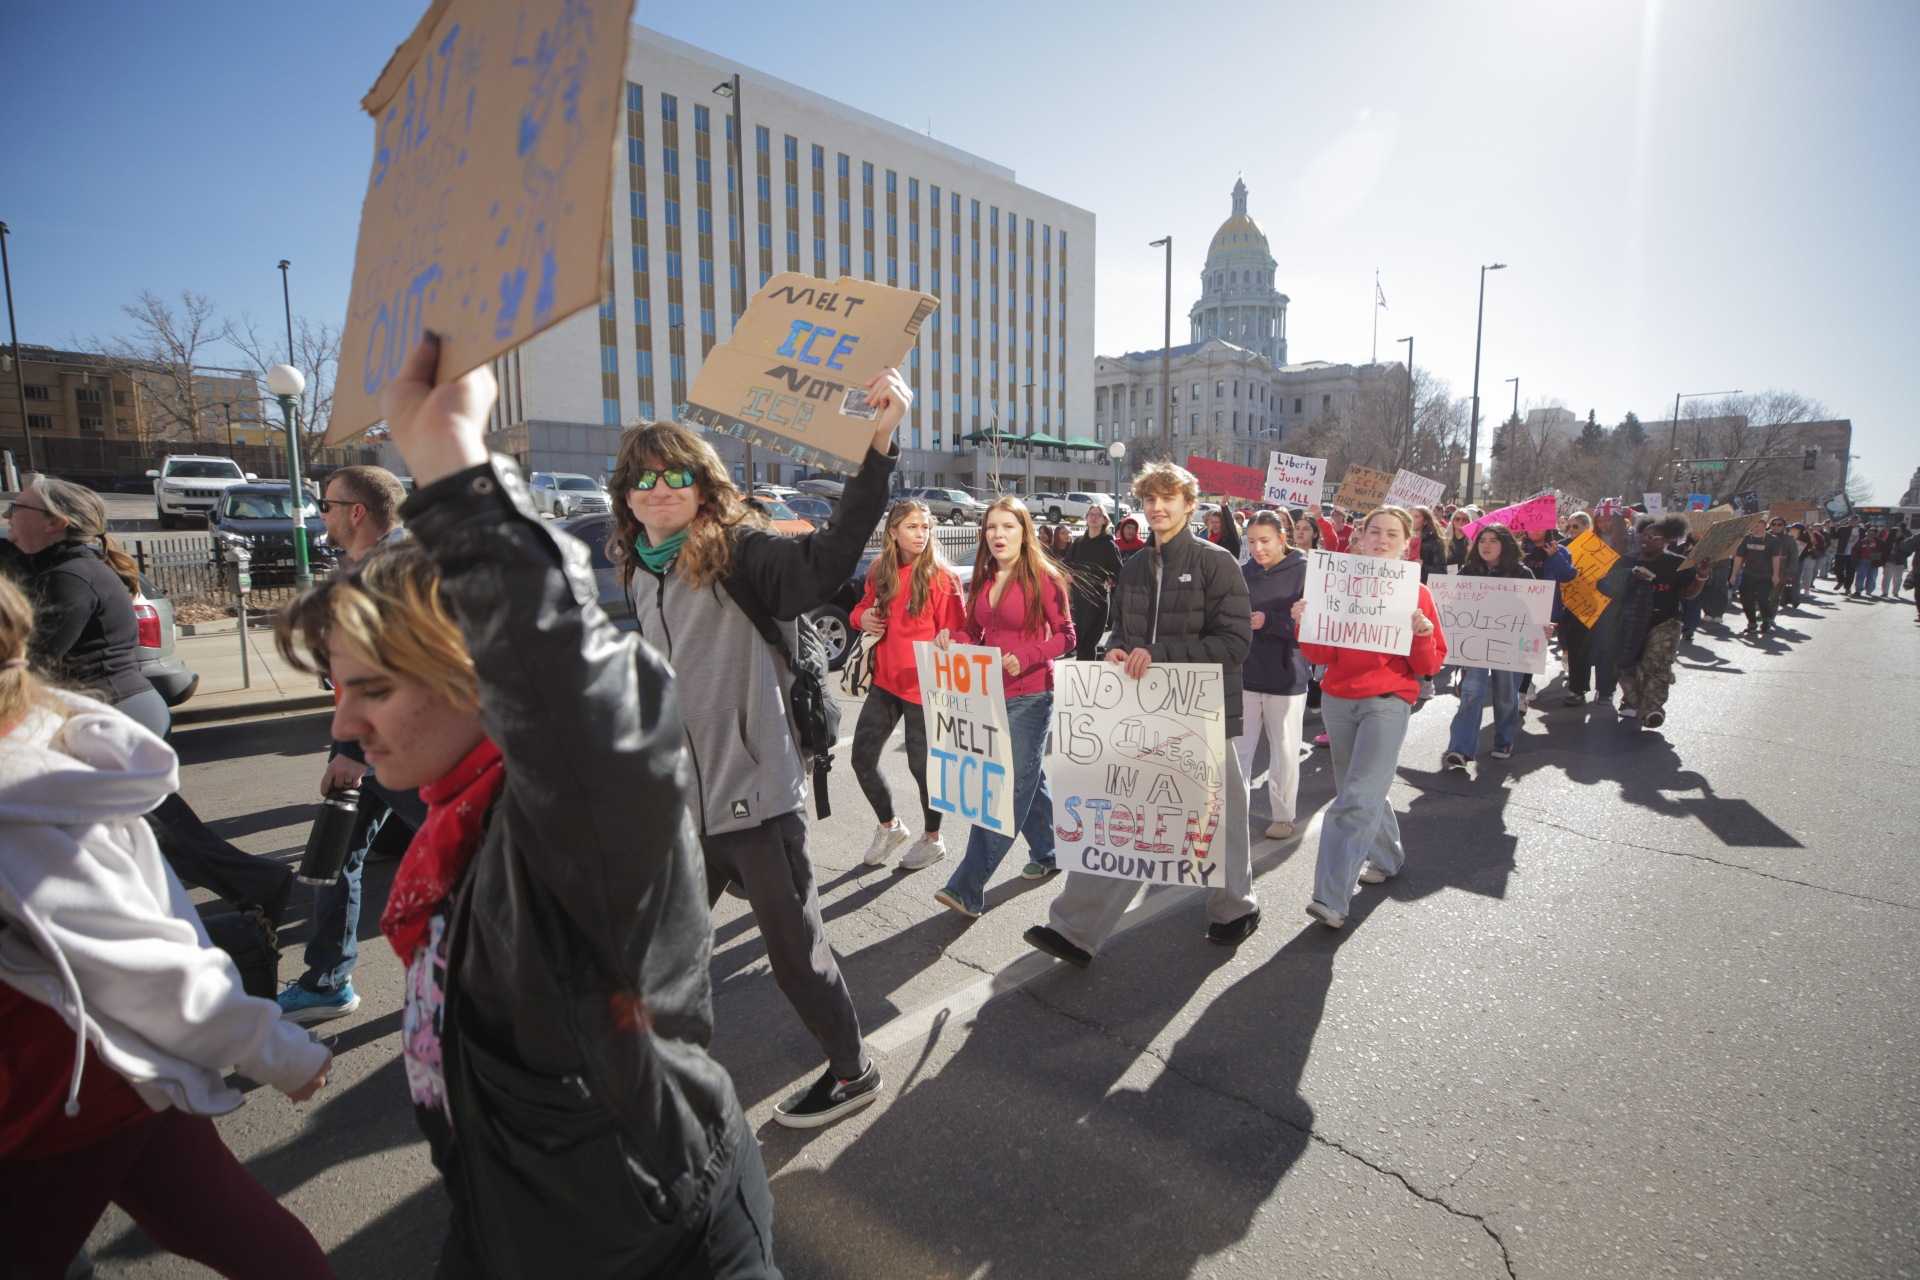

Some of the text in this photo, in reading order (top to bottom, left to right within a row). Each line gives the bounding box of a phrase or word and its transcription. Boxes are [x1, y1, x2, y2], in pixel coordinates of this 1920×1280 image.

[768, 286, 864, 318] MELT
[776, 319, 859, 370] ICE
[764, 365, 844, 402] NOT
[1277, 454, 1317, 476] Liberty
[1279, 473, 1314, 486] Justice
[1269, 486, 1310, 504] FOR ALL
[1315, 551, 1347, 574] This
[1378, 560, 1406, 580] about
[1349, 598, 1387, 616] about
[1317, 613, 1401, 649] HUMANITY
[933, 651, 993, 697] HOT
[1064, 664, 1219, 722] NO ONE
[937, 712, 998, 758] MELT
[1059, 711, 1103, 765] IS
[1115, 719, 1223, 788] ILLEGAL
[930, 748, 1006, 830] ICE
[1106, 764, 1183, 804] IN A
[1056, 795, 1220, 859] STOLEN
[1081, 846, 1217, 886] COUNTRY
